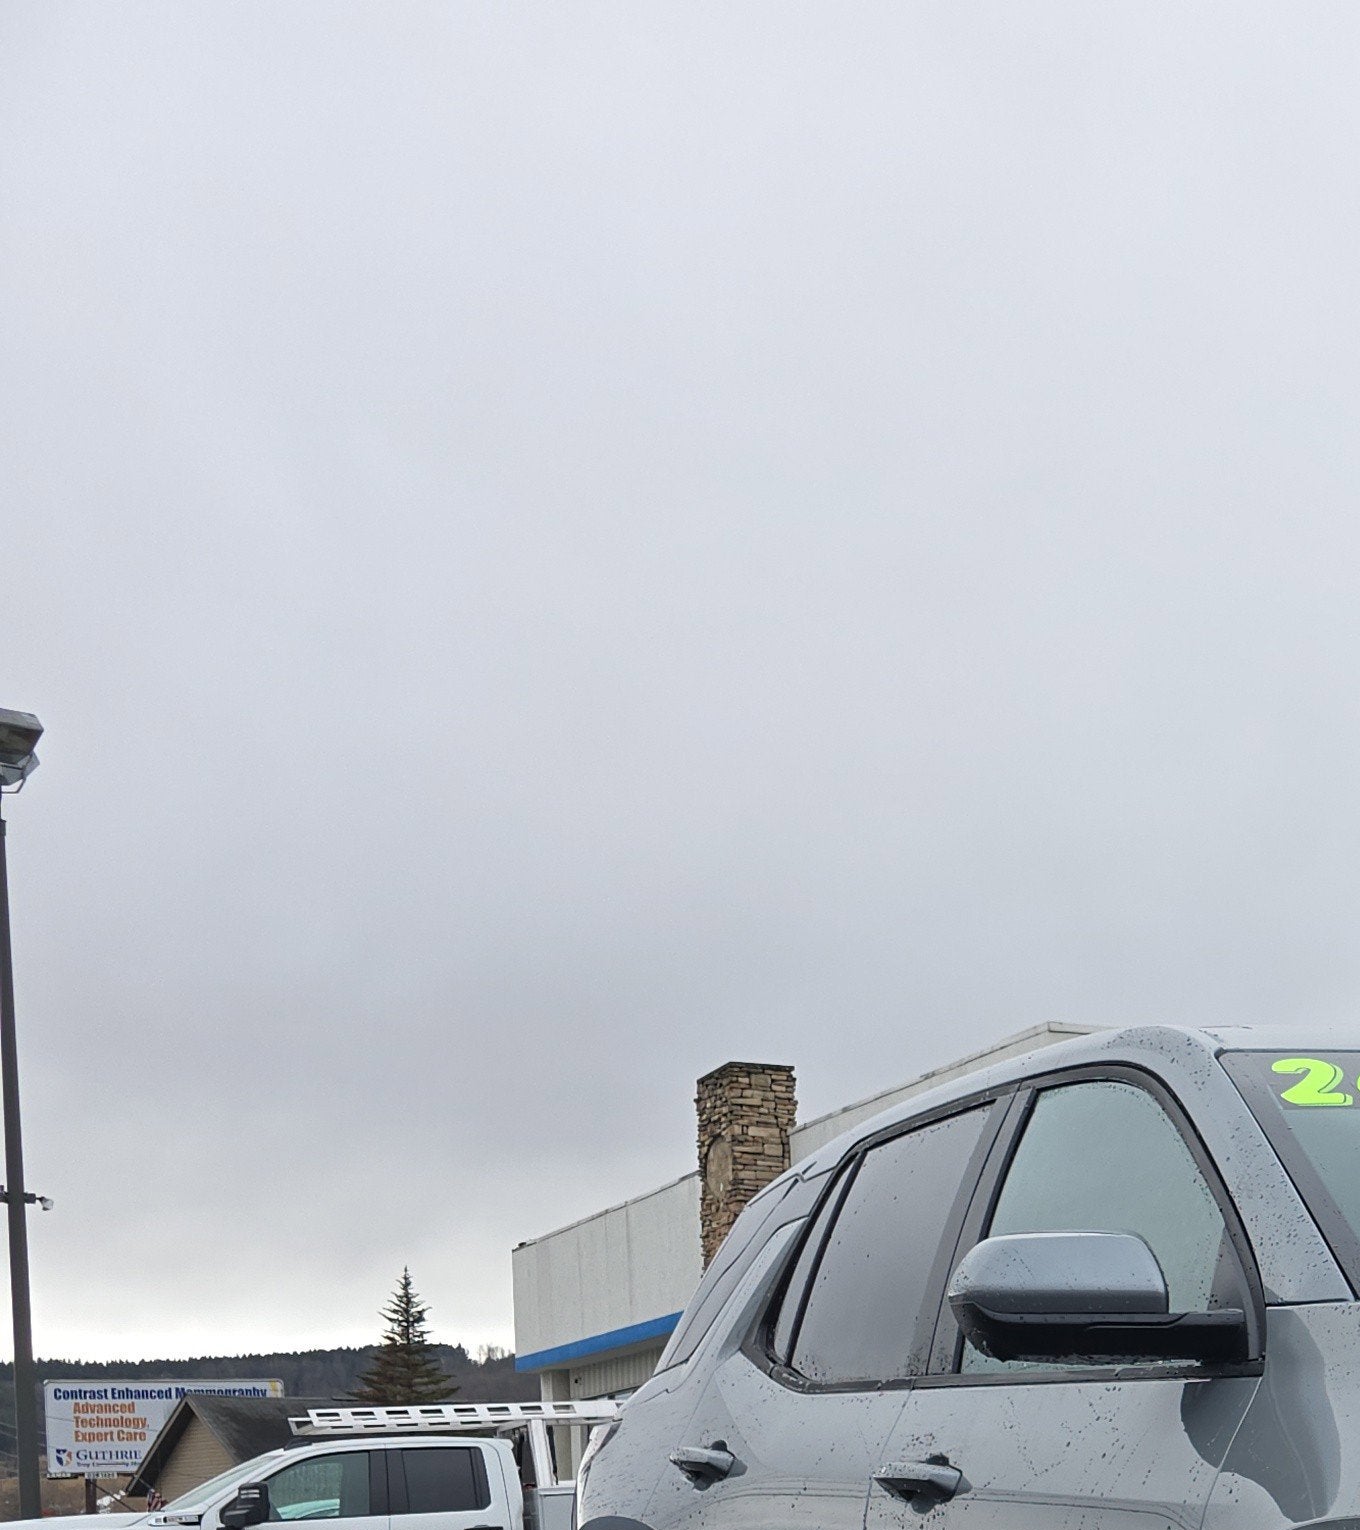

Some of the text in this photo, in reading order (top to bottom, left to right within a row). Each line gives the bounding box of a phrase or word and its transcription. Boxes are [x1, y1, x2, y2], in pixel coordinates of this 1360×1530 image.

[53, 1387, 109, 1400] Contrast
[110, 1387, 172, 1400] Enhanced
[73, 1401, 136, 1414] Advanced
[74, 1429, 147, 1442] Expert Care
[76, 1449, 142, 1461] GUTHRIE
